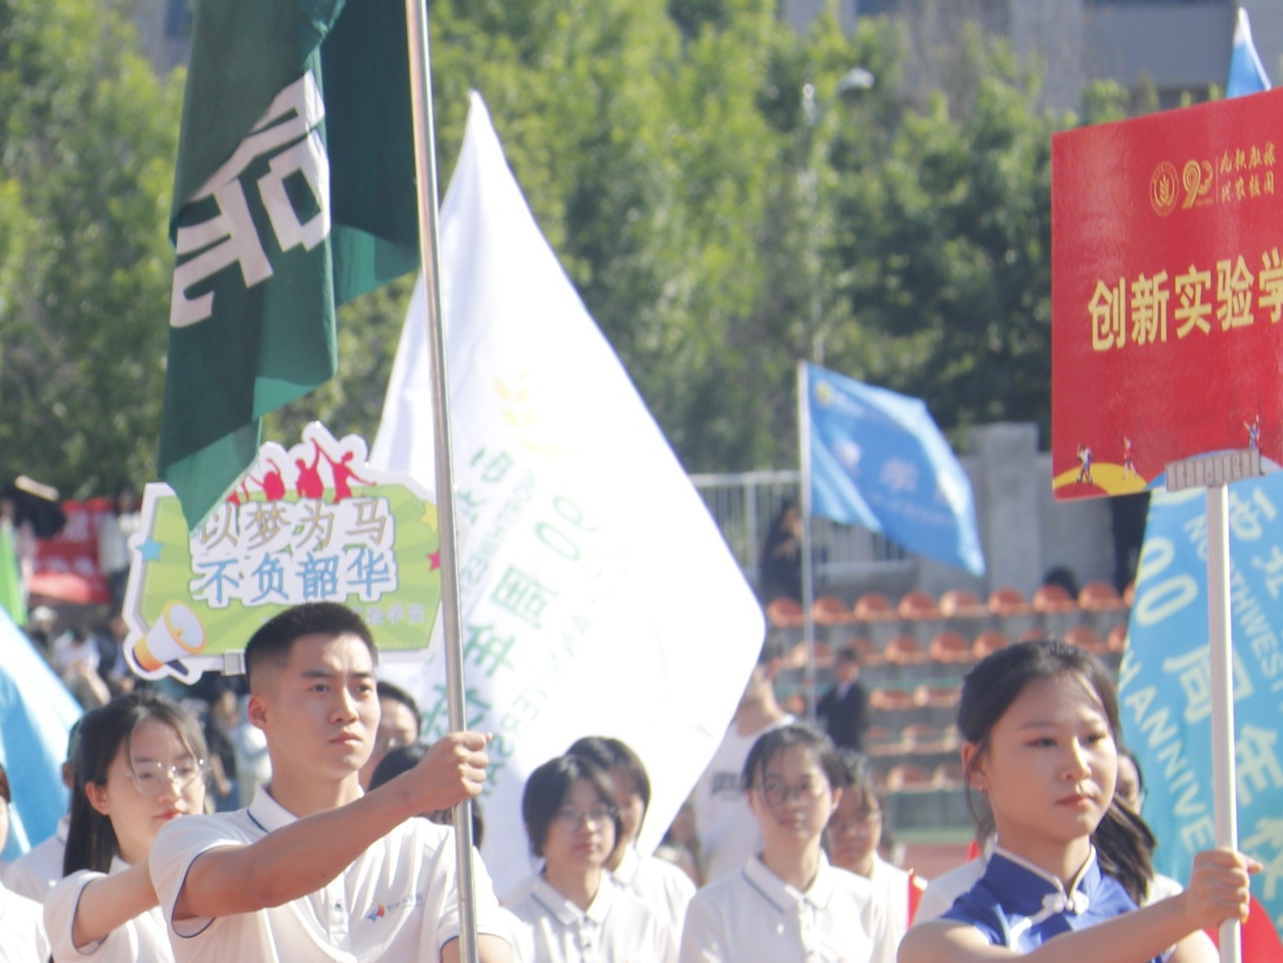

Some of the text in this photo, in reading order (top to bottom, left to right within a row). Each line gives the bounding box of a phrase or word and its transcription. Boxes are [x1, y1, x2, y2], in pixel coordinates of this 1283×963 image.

[198, 498, 388, 551] 以梦为马
[190, 547, 393, 604] 不负韶华
